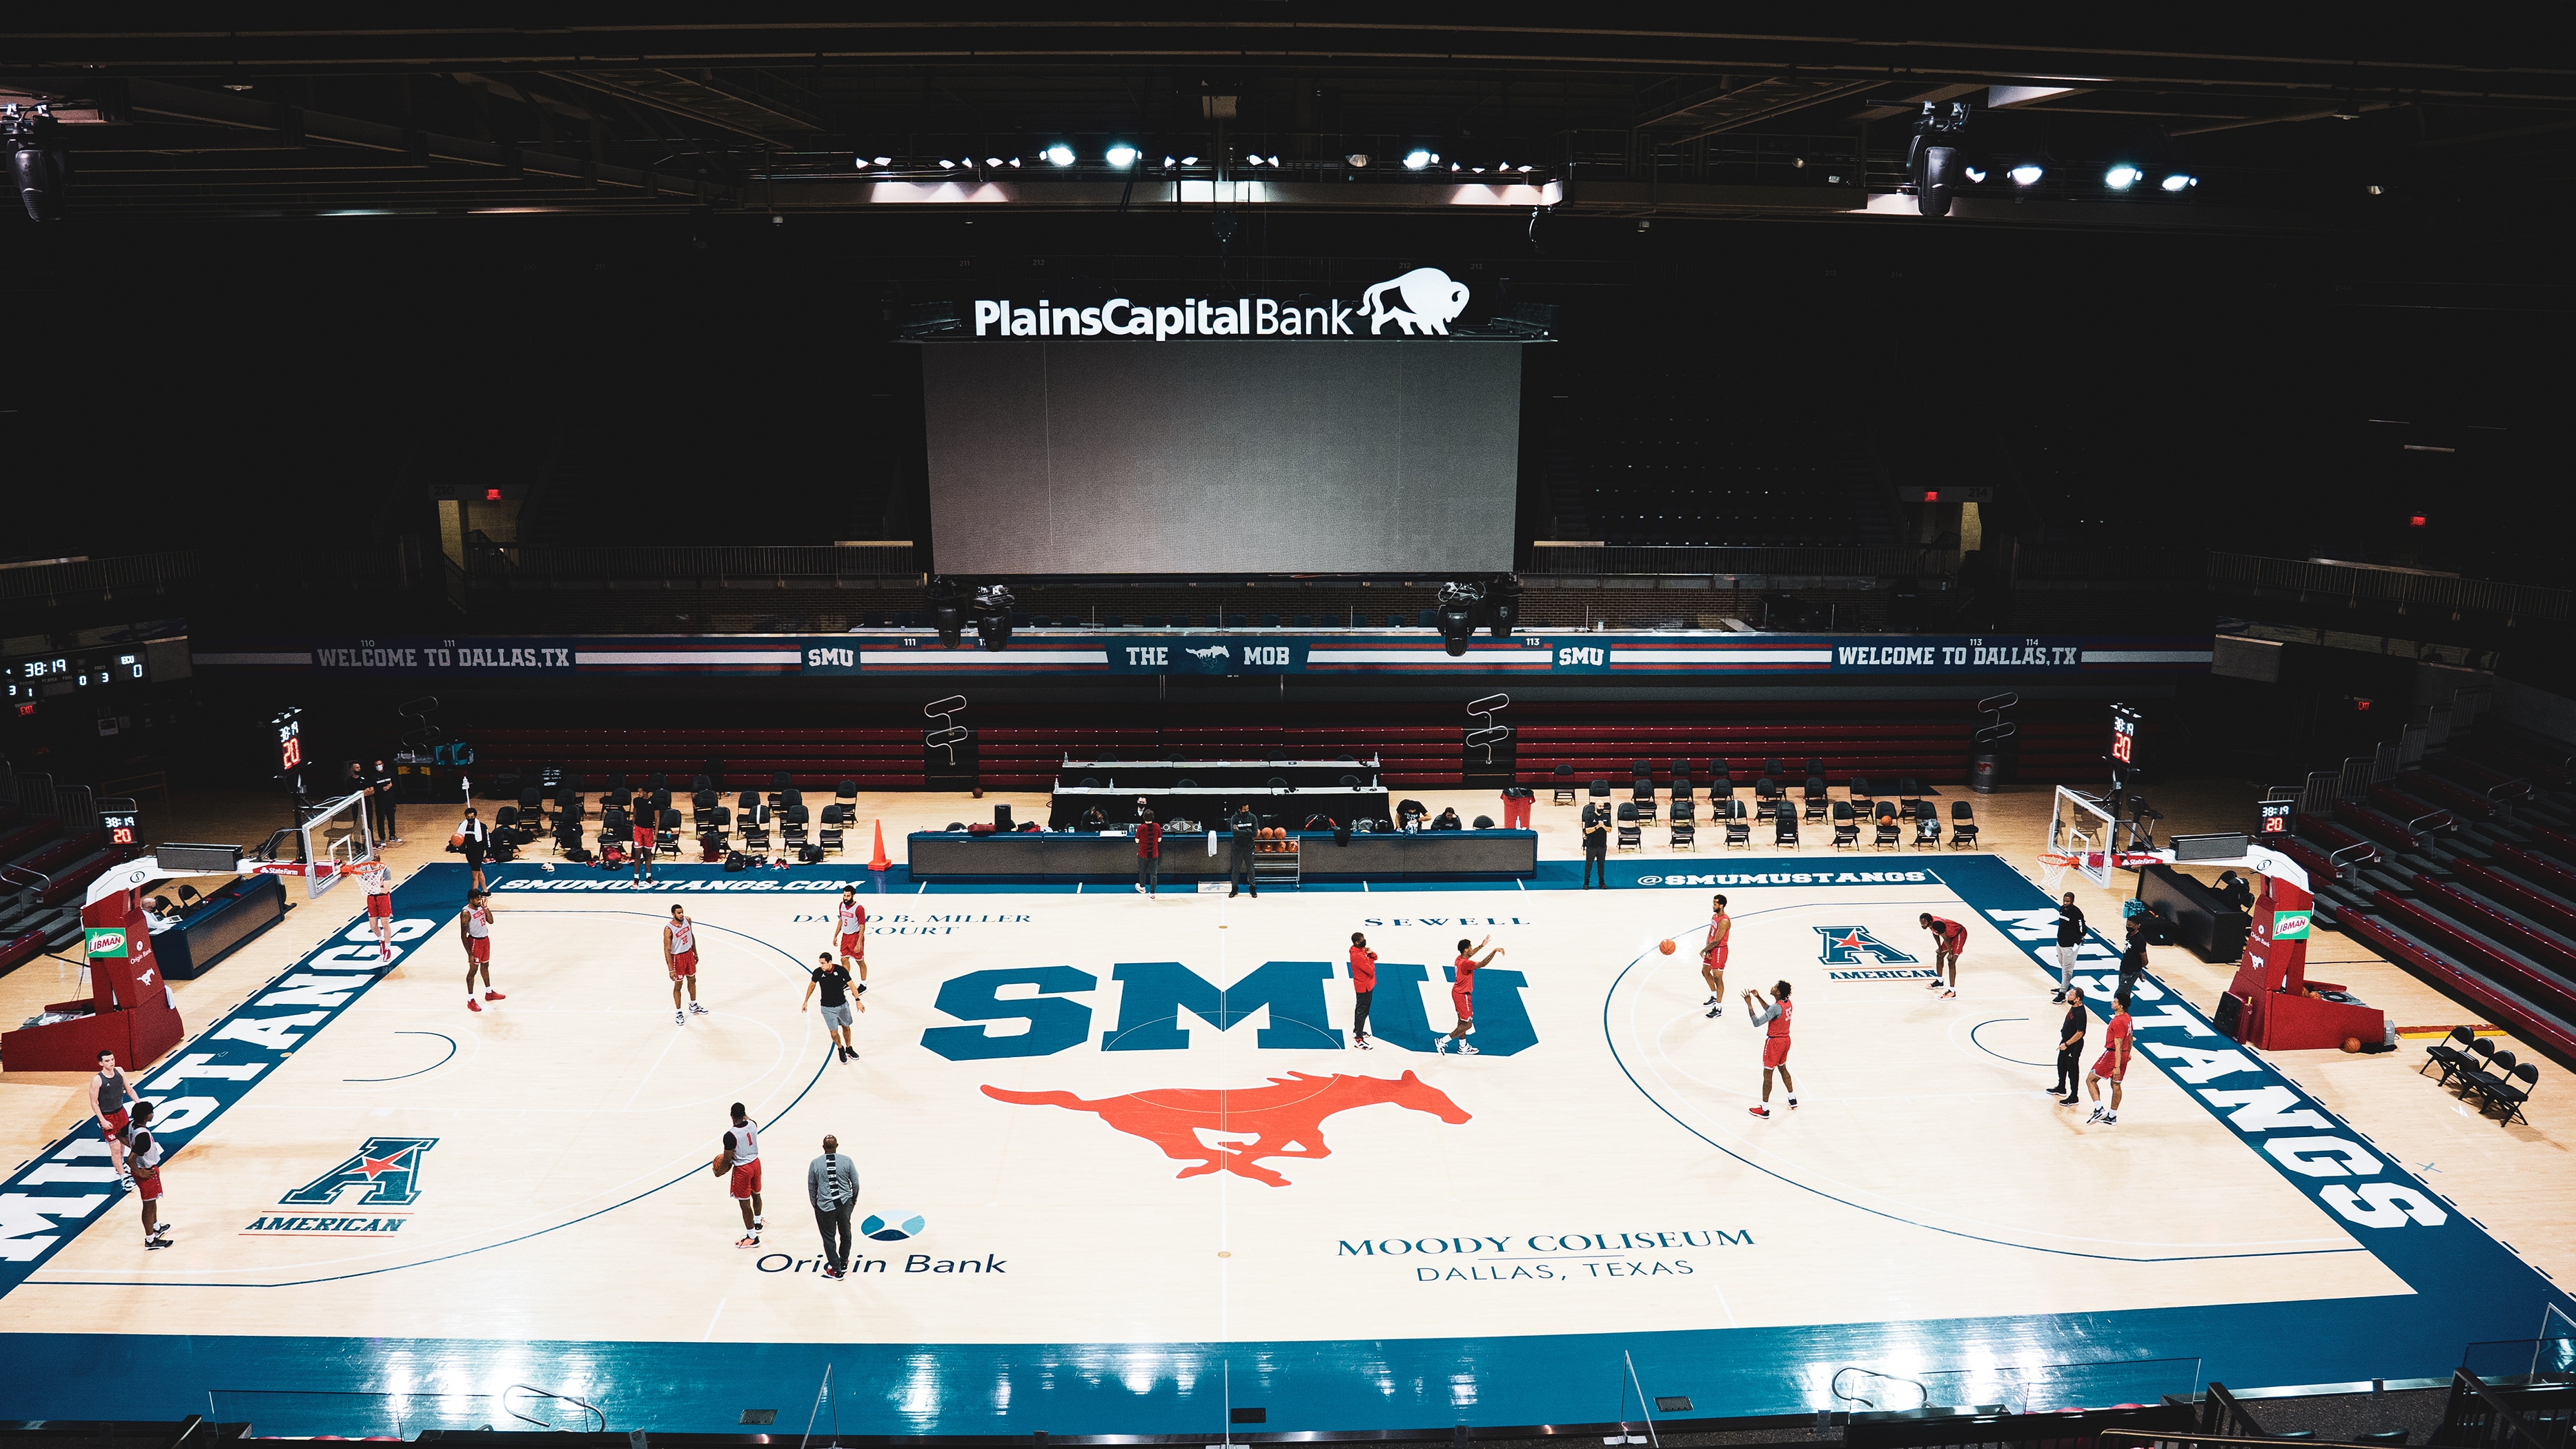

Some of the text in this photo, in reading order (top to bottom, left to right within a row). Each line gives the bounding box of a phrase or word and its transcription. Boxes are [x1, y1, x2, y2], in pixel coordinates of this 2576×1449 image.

[974, 298, 1355, 342] PlainsCapital Bank
[360, 640, 375, 648] 110
[443, 640, 455, 648] 111
[903, 638, 916, 647] 111
[1525, 638, 1540, 647] 113
[1969, 638, 1983, 647] 113
[2025, 638, 2039, 647] 114
[317, 648, 417, 667] WELCOME
[424, 648, 451, 667] TO
[808, 648, 854, 667] SMU
[1125, 647, 1290, 666] THE MOB
[1559, 647, 1604, 667] SMU
[1838, 647, 1936, 665] WELCOME
[1942, 647, 1967, 665] TO
[24, 658, 67, 678] 38:19
[132, 664, 143, 678] 0
[79, 675, 87, 687] 0
[101, 672, 109, 683] 3
[9, 685, 17, 696] 3
[20, 704, 34, 716] EXIT
[282, 738, 301, 768] 20
[2113, 732, 2131, 761] 20
[2265, 817, 2283, 831] 20
[112, 828, 132, 843] 20
[1638, 871, 1926, 885] @SMUMUSTANGS
[793, 914, 884, 923] DAD
[894, 914, 915, 923] B.
[927, 914, 1032, 923] MILLER
[1364, 917, 1531, 927] SEWELL
[2274, 919, 2305, 935] LIBMAN
[89, 936, 121, 952] LIBMAN
[1829, 969, 1938, 980] AMERICAN
[919, 960, 1540, 1062] SMU
[745, 1132, 753, 1146] 1
[245, 1216, 407, 1232] AMERICAN
[1335, 1229, 1758, 1256] MOODY COLISEUM
[756, 1253, 1008, 1279] Oriin Bank
[1416, 1260, 1695, 1282] DALLAS, TEXAS
